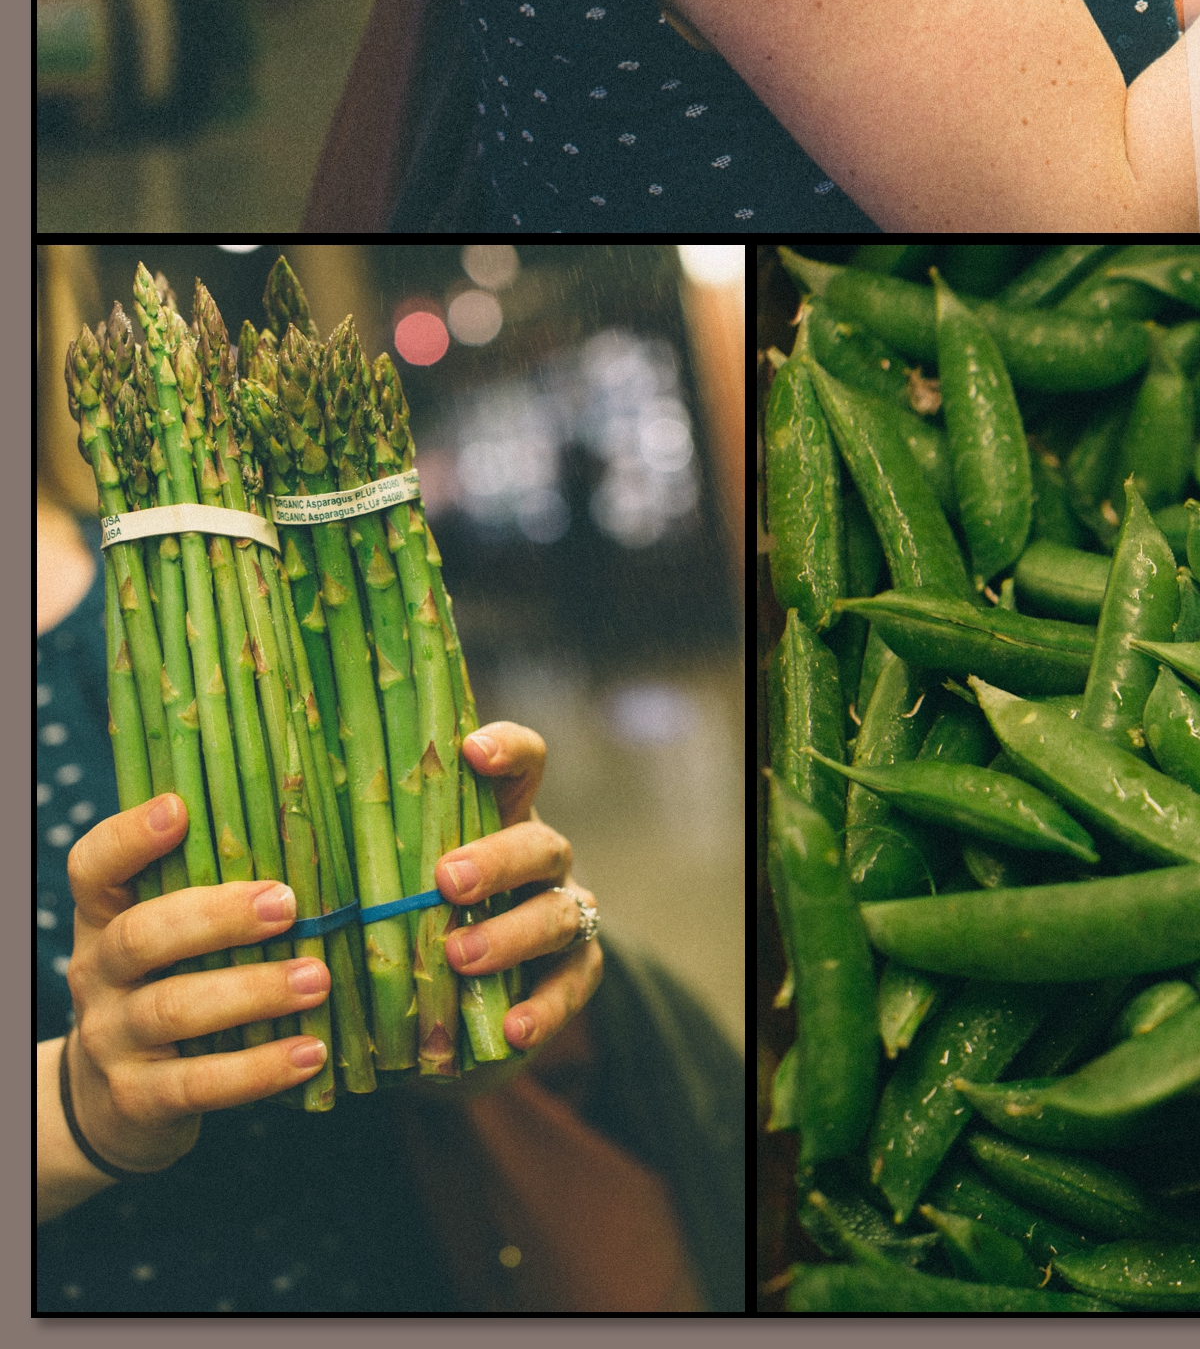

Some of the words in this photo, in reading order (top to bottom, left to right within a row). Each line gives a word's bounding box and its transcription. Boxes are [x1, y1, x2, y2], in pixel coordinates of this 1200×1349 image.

[275, 498, 304, 510] ORGANIC
[306, 495, 353, 510] Asparagus
[355, 486, 377, 501] PLU#
[276, 510, 306, 522] ORGANIC
[308, 507, 355, 523] Asparagus
[357, 498, 380, 512] PLU#
[103, 514, 121, 528] USA
[106, 527, 122, 541] USA
